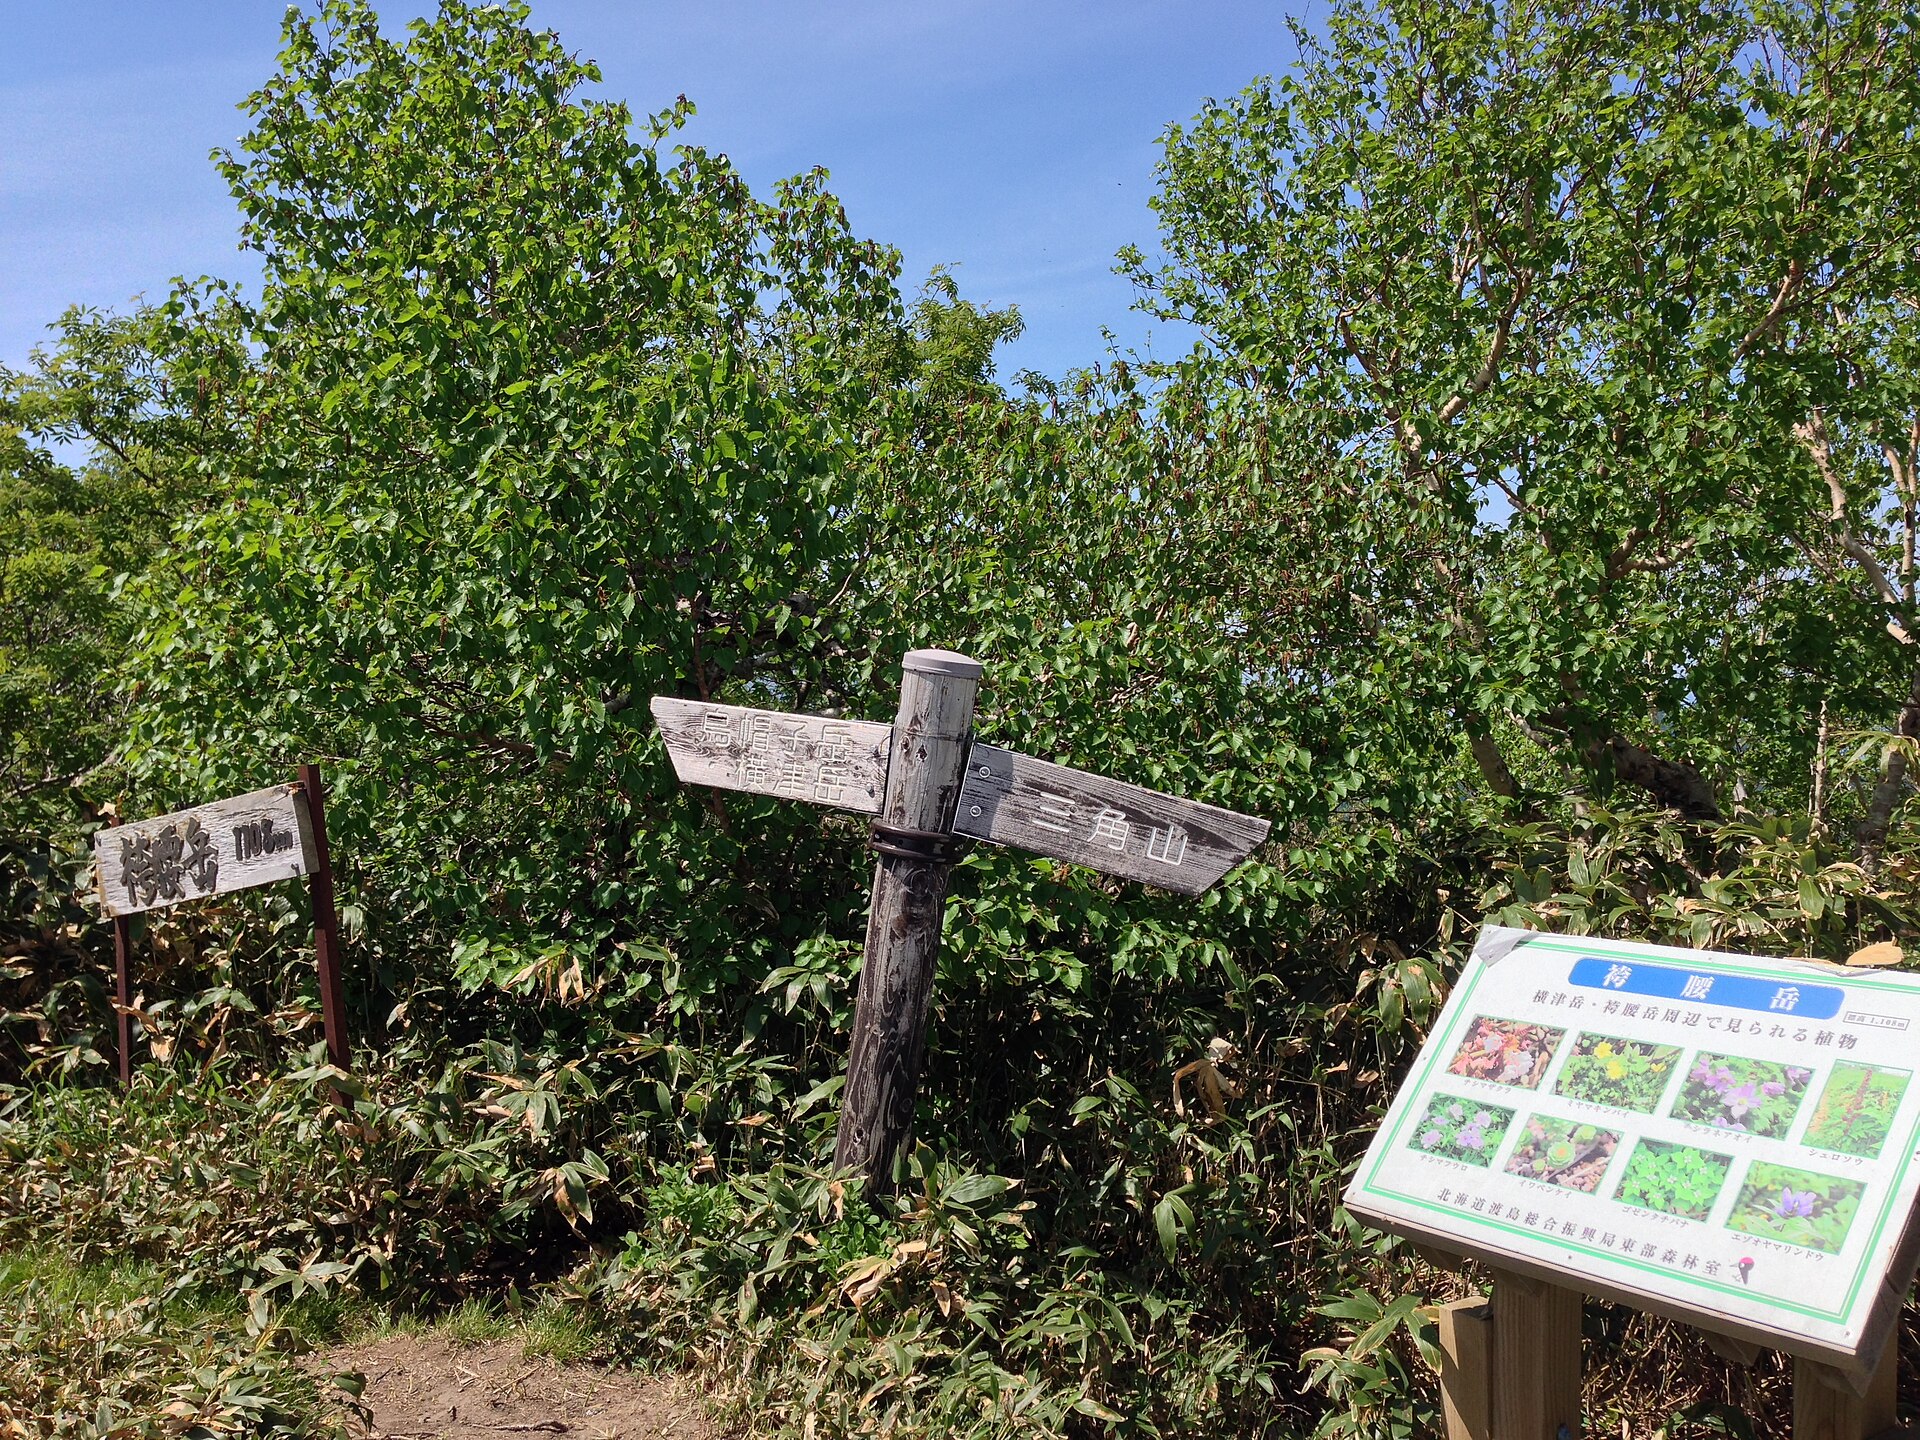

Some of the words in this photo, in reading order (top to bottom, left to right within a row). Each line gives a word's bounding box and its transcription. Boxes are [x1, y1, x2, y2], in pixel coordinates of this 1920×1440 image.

[734, 753, 848, 801] 横津岳
[232, 818, 293, 862] 1108m
[1032, 791, 1188, 866] 三角山
[1602, 964, 1801, 1011] 袴腰岳
[1532, 989, 1859, 1050] 横津岳・袴腰岳周辺で見られる植物
[1437, 1188, 1722, 1277] 北海道渡島総合振興局東部森林室
[1731, 1232, 1825, 1262] エゾオヤマリンドウ
